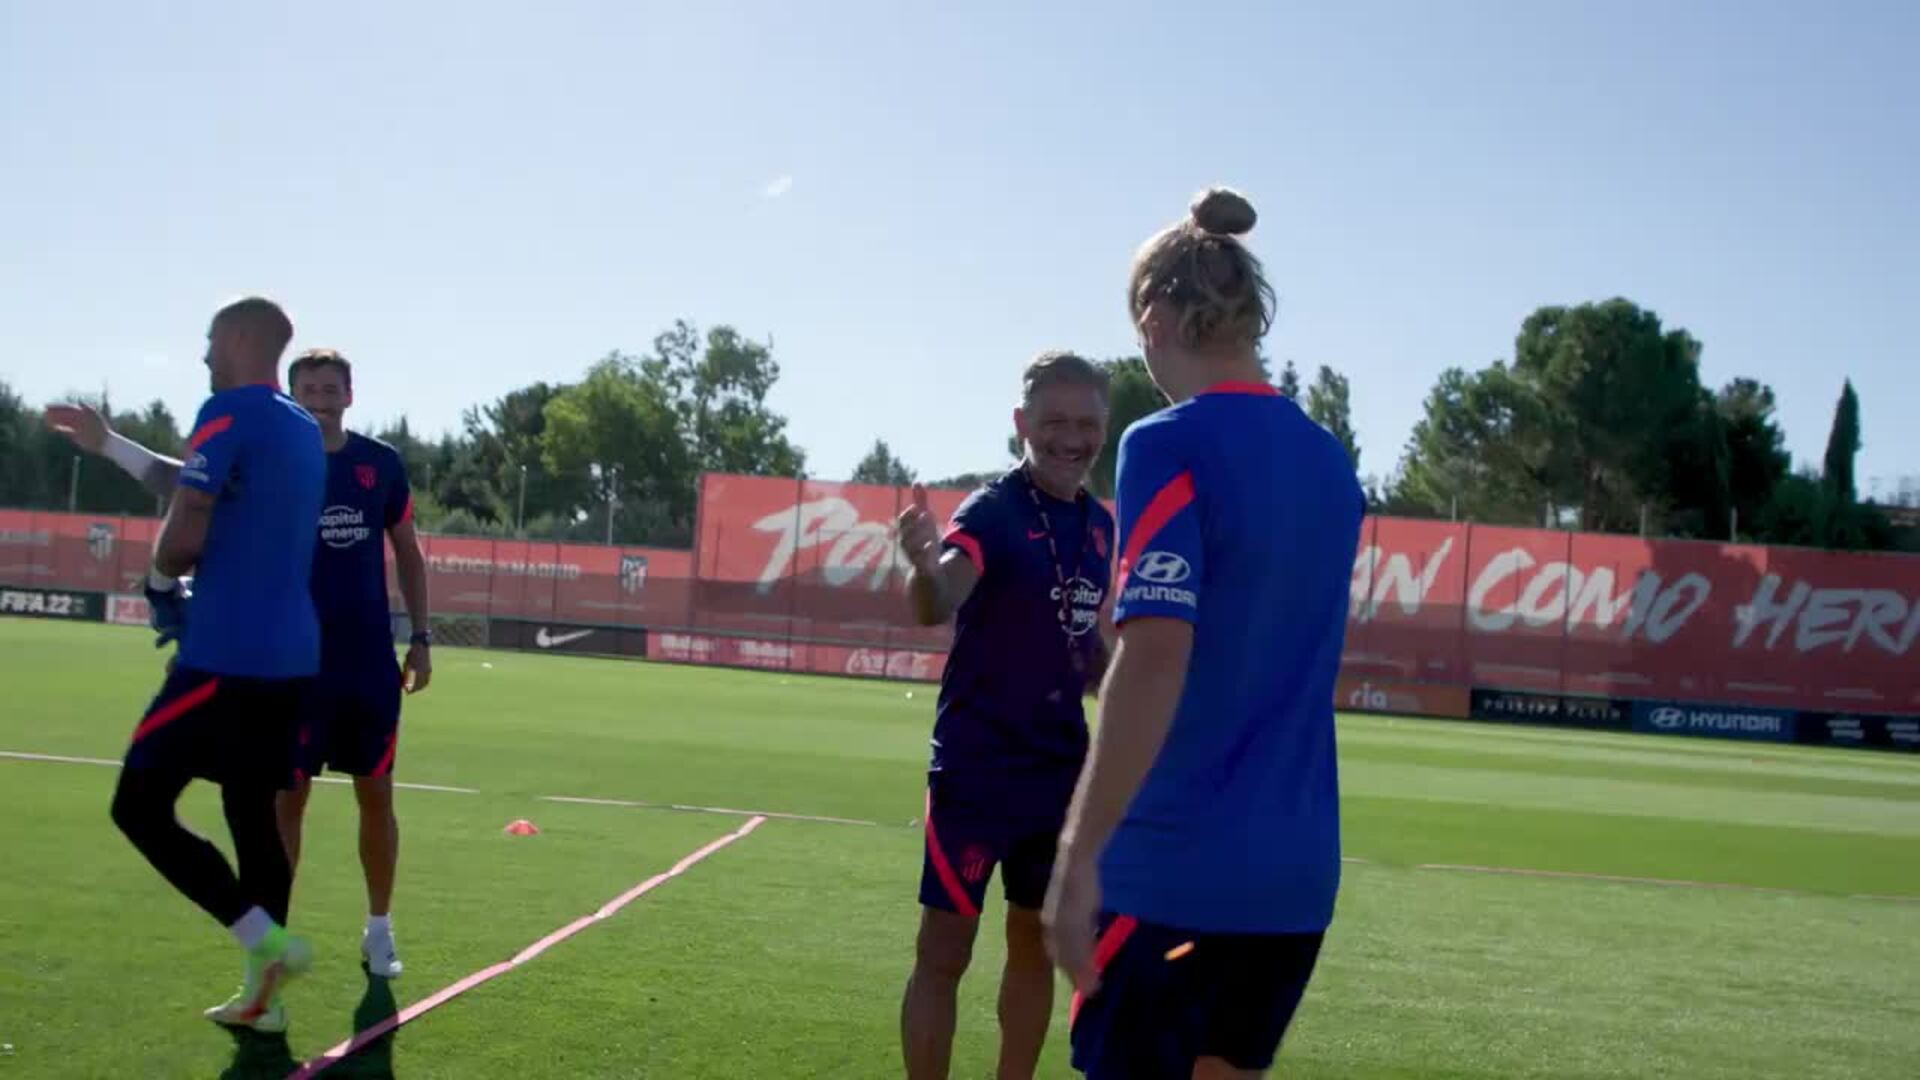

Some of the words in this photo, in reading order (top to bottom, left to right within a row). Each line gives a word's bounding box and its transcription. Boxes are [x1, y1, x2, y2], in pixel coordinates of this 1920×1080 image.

[1050, 584, 1103, 605] cpital
[1466, 547, 1711, 645] COMO
[1730, 571, 1920, 655] HER
[1690, 711, 1782, 733] HYUNDAI
